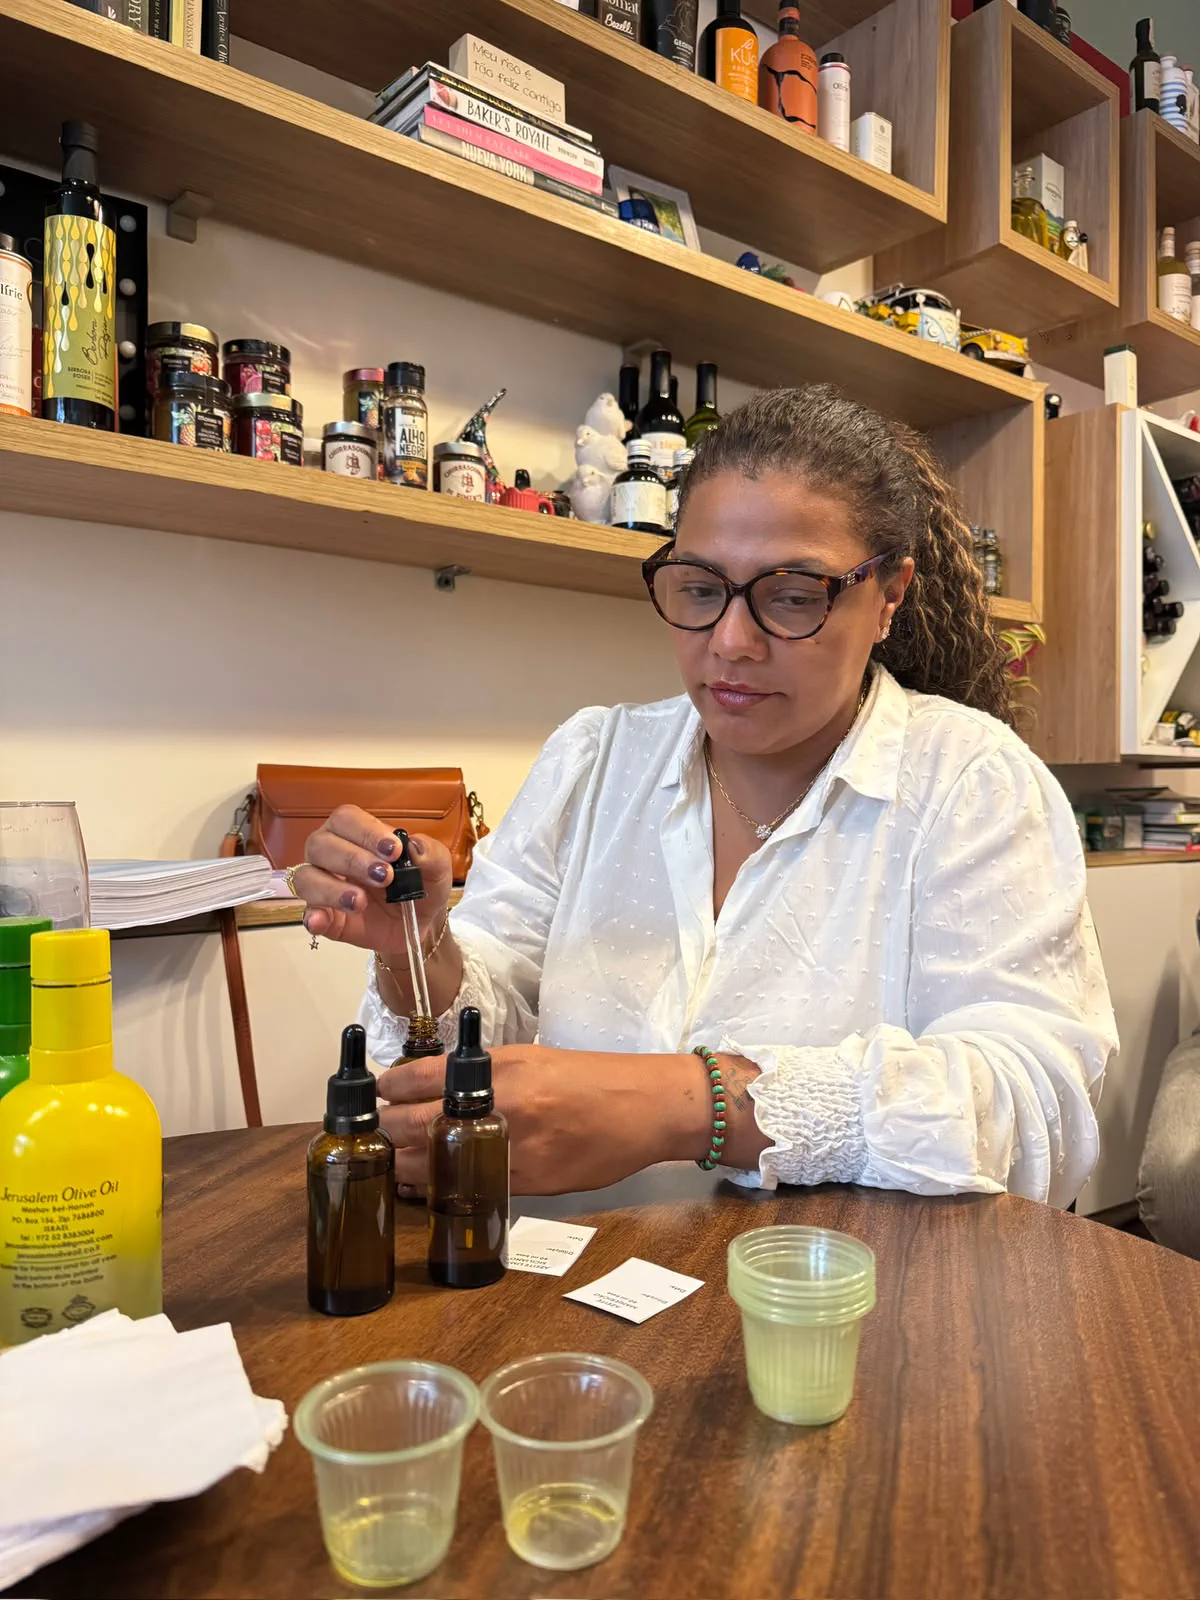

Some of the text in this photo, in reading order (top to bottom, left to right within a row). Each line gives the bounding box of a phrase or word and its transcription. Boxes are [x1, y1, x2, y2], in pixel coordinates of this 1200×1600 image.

[472, 41, 498, 63] Meu
[501, 57, 521, 75] riso
[473, 59, 494, 78] tão
[497, 72, 520, 92] feliz
[522, 87, 562, 113] contigo
[467, 99, 511, 133] BAKER'S
[516, 121, 551, 152] ROYALE
[461, 141, 528, 183] NUEVA YORK
[399, 427, 425, 445] ALHO
[1, 1180, 119, 1203] Jerusalem Olive Oil
